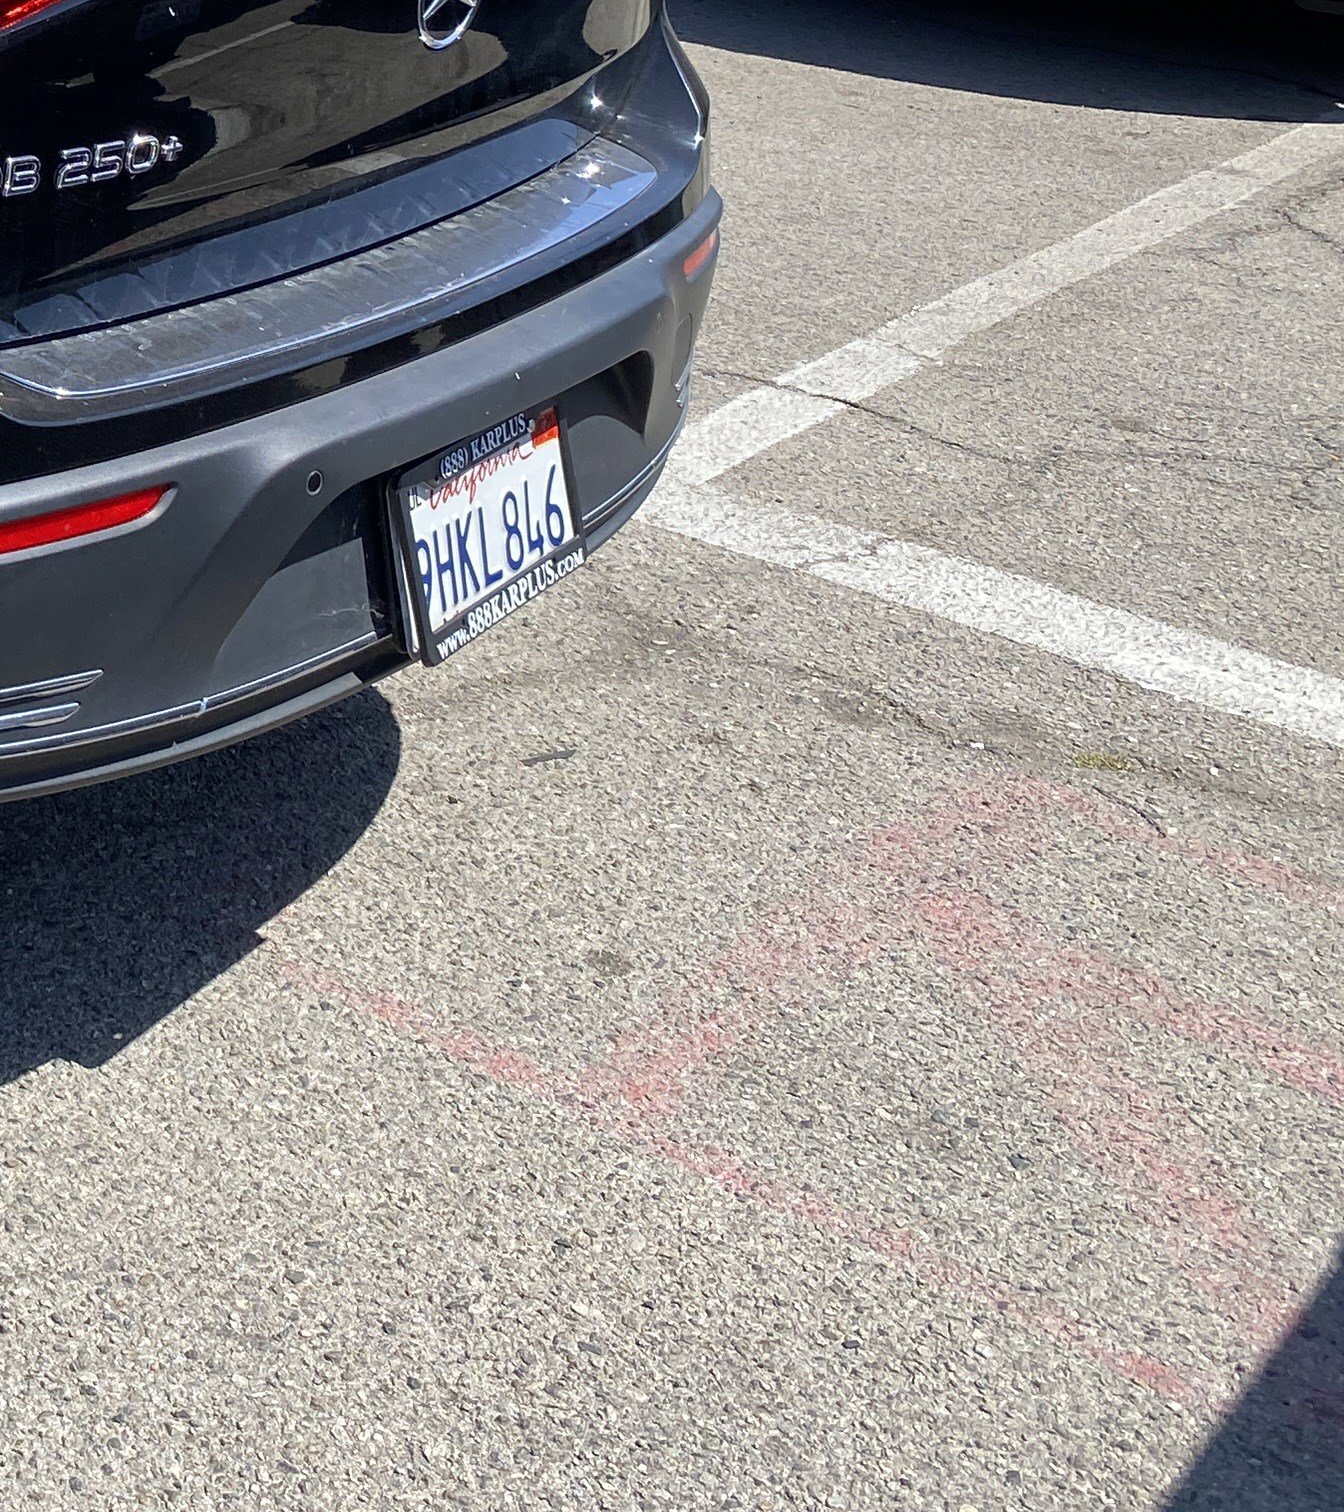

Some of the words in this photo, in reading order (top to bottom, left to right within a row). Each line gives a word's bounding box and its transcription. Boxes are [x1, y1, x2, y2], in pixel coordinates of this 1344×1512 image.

[53, 134, 184, 189] 250+
[440, 447, 468, 479] (888)
[470, 413, 526, 461] KARPLUS
